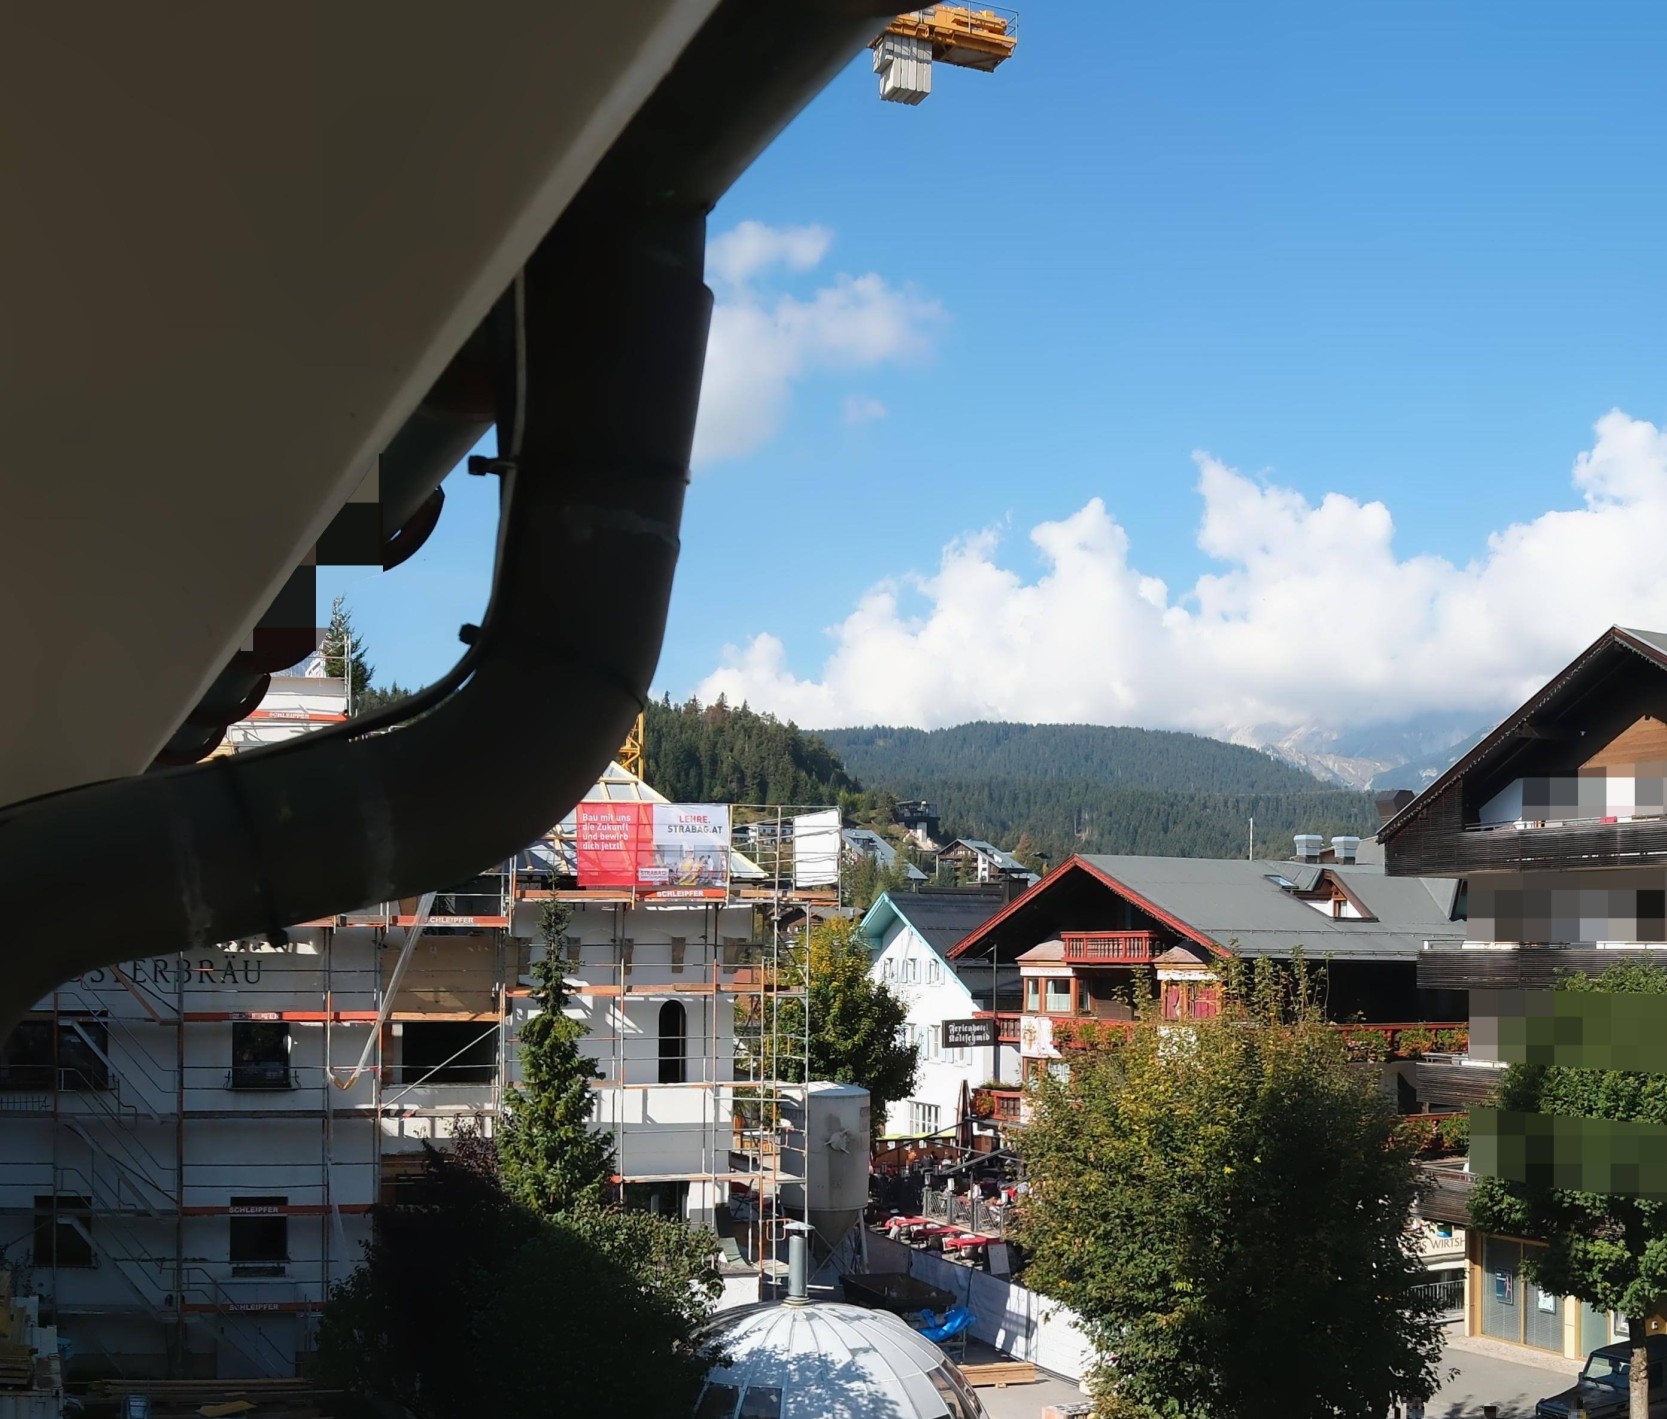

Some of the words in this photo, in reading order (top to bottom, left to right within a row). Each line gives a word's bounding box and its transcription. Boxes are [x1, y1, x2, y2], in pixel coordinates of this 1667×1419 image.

[582, 813, 598, 822] Bau
[600, 813, 614, 822] mit
[679, 815, 711, 824] LEHRE.
[597, 823, 629, 832] Zukunft
[667, 824, 722, 835] STRABAG.AT
[600, 833, 629, 841] bewirb
[582, 842, 599, 850] dich
[601, 842, 623, 852] jetzt!
[656, 890, 704, 898] SCHLEIPFER
[229, 1206, 279, 1215] SCHLEIPFER
[229, 1303, 279, 1312] SCHLEIPFER
